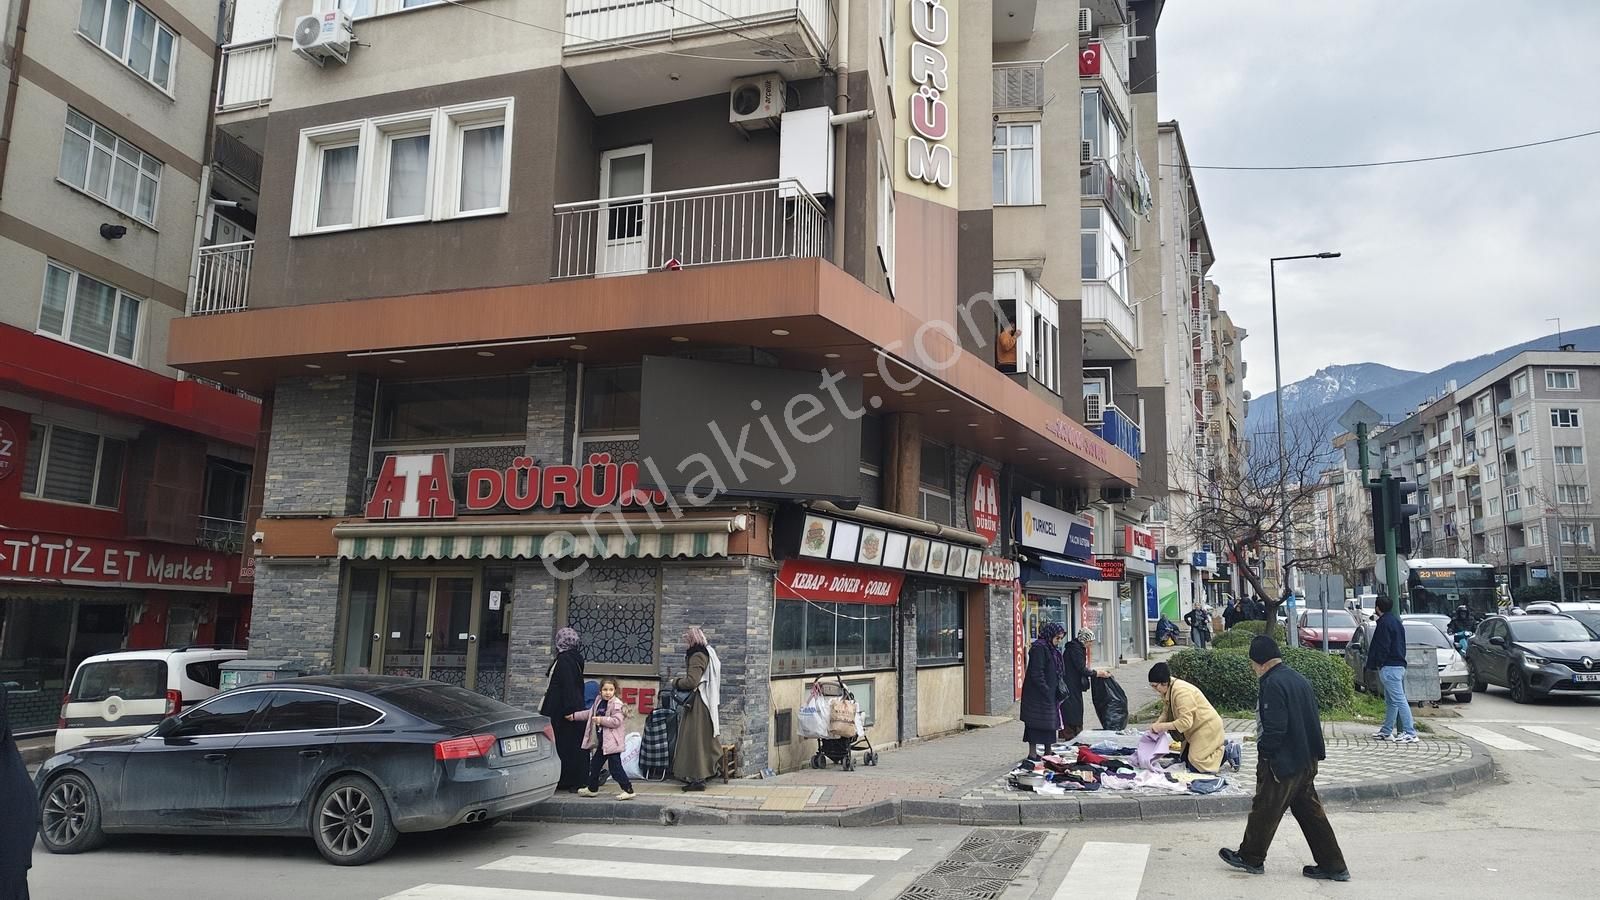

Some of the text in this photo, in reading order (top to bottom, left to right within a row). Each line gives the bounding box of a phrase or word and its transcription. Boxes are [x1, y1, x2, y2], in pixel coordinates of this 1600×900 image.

[364, 453, 456, 520] ATA
[976, 514, 997, 532] DÜRÜM
[1032, 517, 1057, 536] TURKCELL
[103, 548, 141, 581] ET
[147, 553, 214, 583] Market
[791, 572, 892, 599] KEBAP DÖNER ÇORBA
[1015, 602, 1023, 689] vodafone
[621, 687, 655, 715] FE
